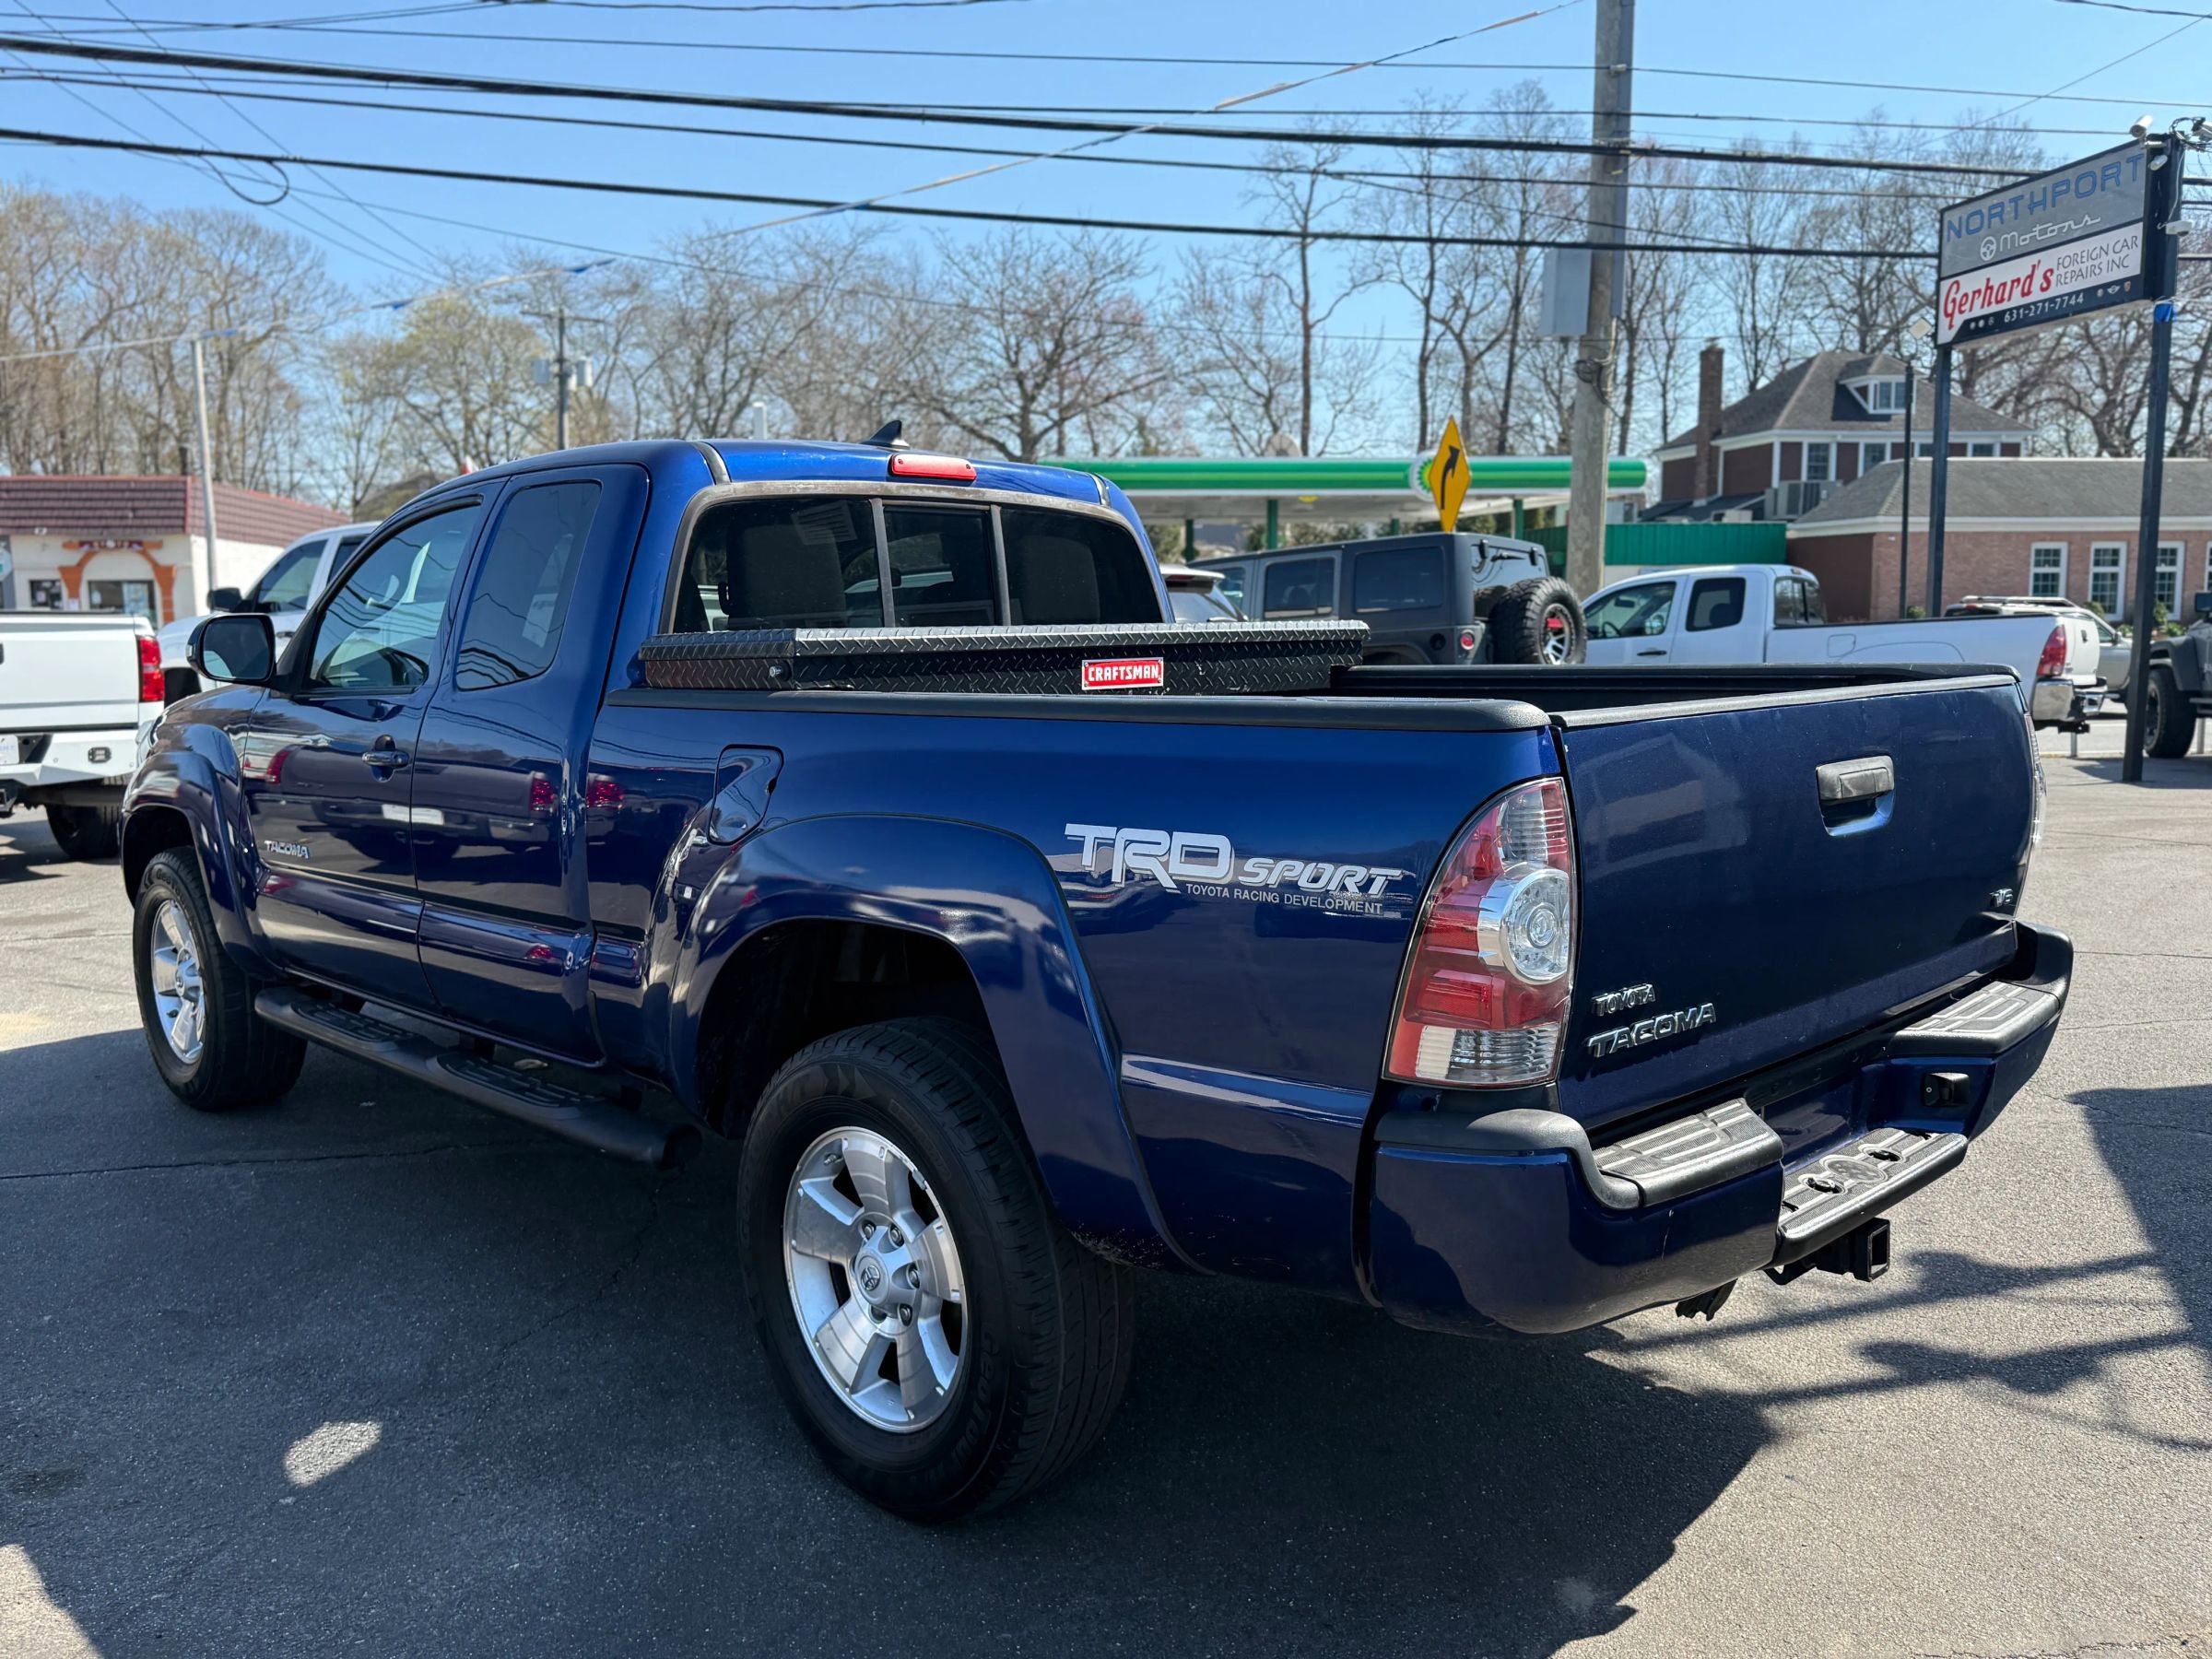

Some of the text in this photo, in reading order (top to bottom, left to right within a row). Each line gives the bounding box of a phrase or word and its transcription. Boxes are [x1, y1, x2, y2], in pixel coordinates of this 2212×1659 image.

[1946, 153, 2145, 242] NORTHPORT
[2055, 253, 2130, 288] REPAIRS INC
[2056, 235, 2139, 271] FOREIGN CAR
[1943, 259, 2055, 331] Gerhard's
[2004, 292, 2085, 324] 631-271-7744
[1088, 664, 1159, 682] CRAFTSMAN
[264, 840, 310, 859] TACOMA
[1064, 822, 1403, 898] TRD SPORT
[1185, 882, 1383, 915] TOYOTA RACING DEVELOPMENT
[1592, 983, 1656, 1017] TOYOTA
[1587, 1002, 1717, 1058] TACOMA
